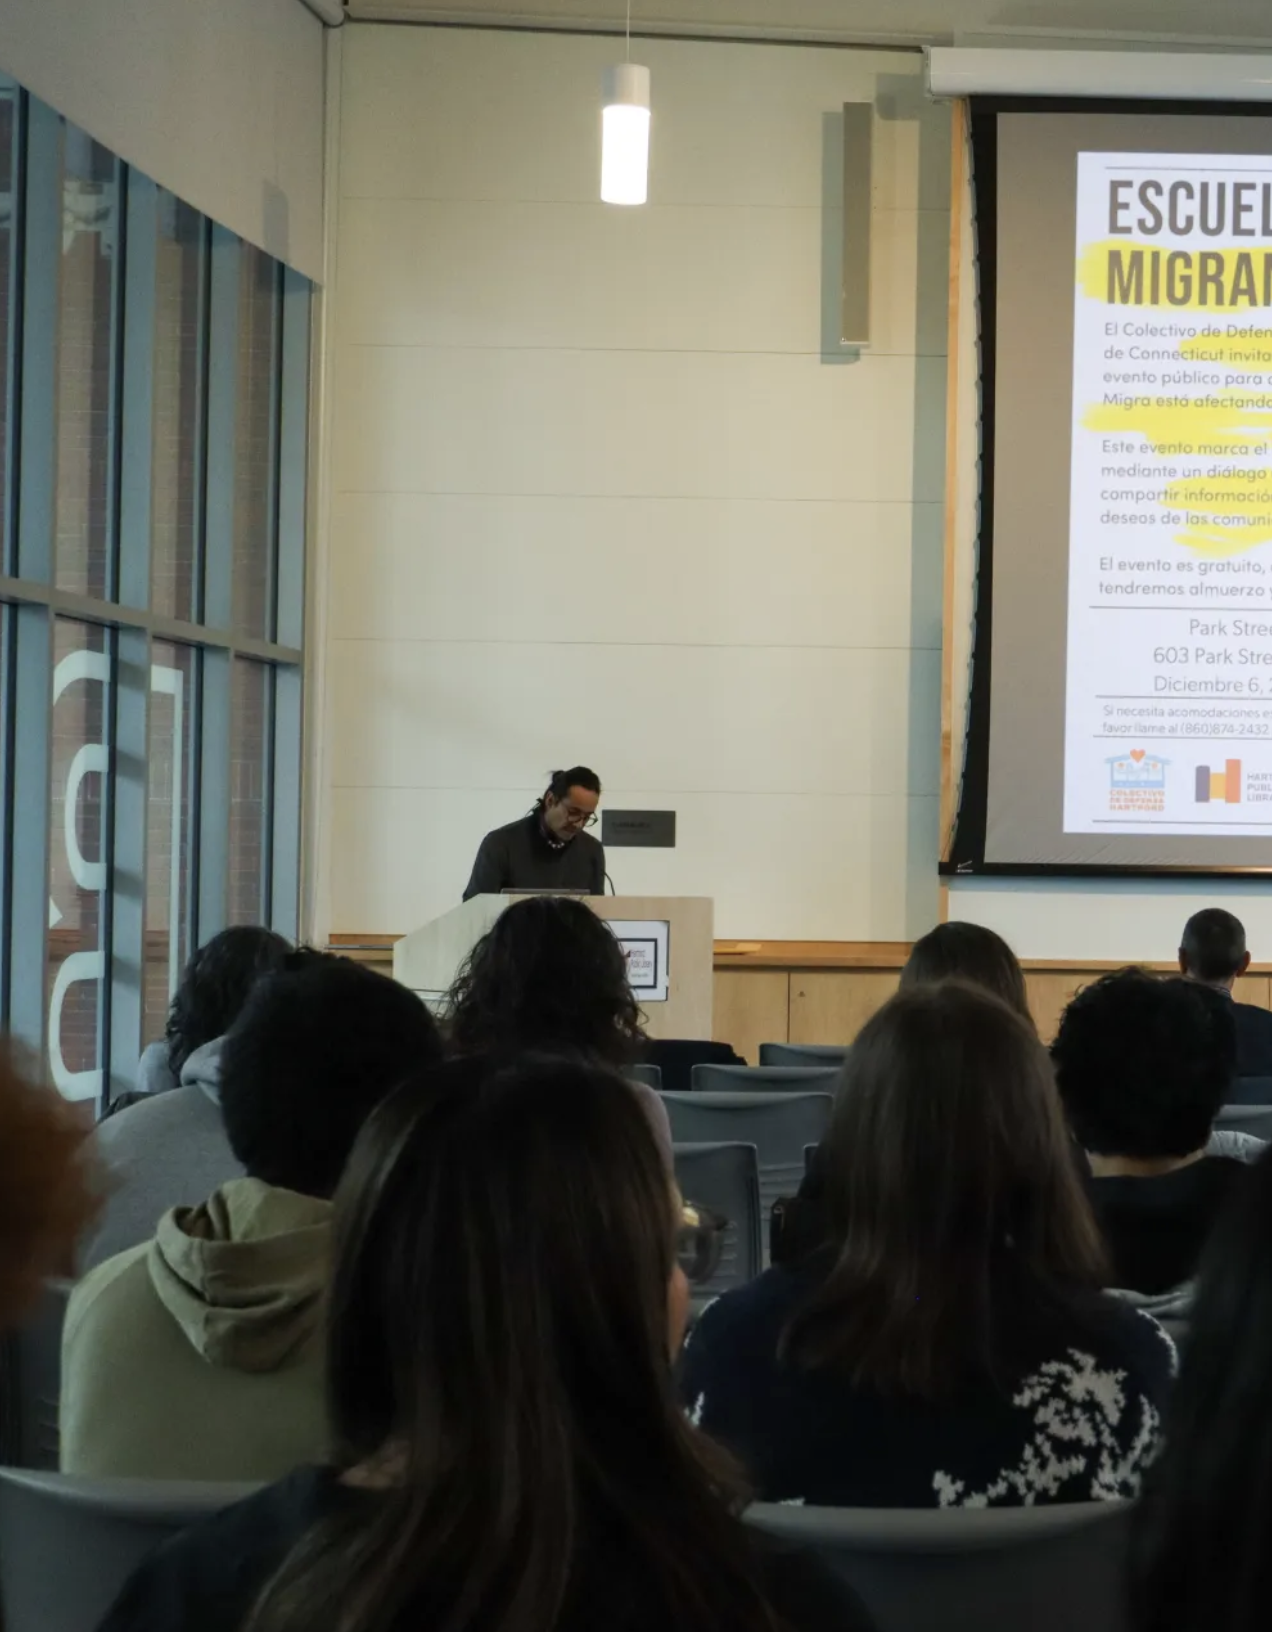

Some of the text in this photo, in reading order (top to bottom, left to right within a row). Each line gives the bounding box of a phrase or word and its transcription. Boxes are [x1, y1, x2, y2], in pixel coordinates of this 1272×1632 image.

[1105, 322, 1118, 337] El
[1123, 322, 1196, 338] Colectivo
[1201, 322, 1221, 338] de
[1104, 344, 1124, 360] de
[1128, 345, 1224, 362] Connecticut
[1103, 370, 1157, 384] evento
[1161, 370, 1220, 388] público
[1225, 373, 1263, 389] para
[1103, 392, 1151, 412] Migra
[1156, 394, 1190, 408] está
[1099, 580, 1185, 596] tendremos
[1189, 581, 1265, 598] almuerzo
[1190, 618, 1228, 637] Park
[1153, 646, 1189, 665] 603
[1195, 647, 1233, 665] Park
[1154, 674, 1244, 692] Diciembre
[1248, 676, 1263, 695] 6,
